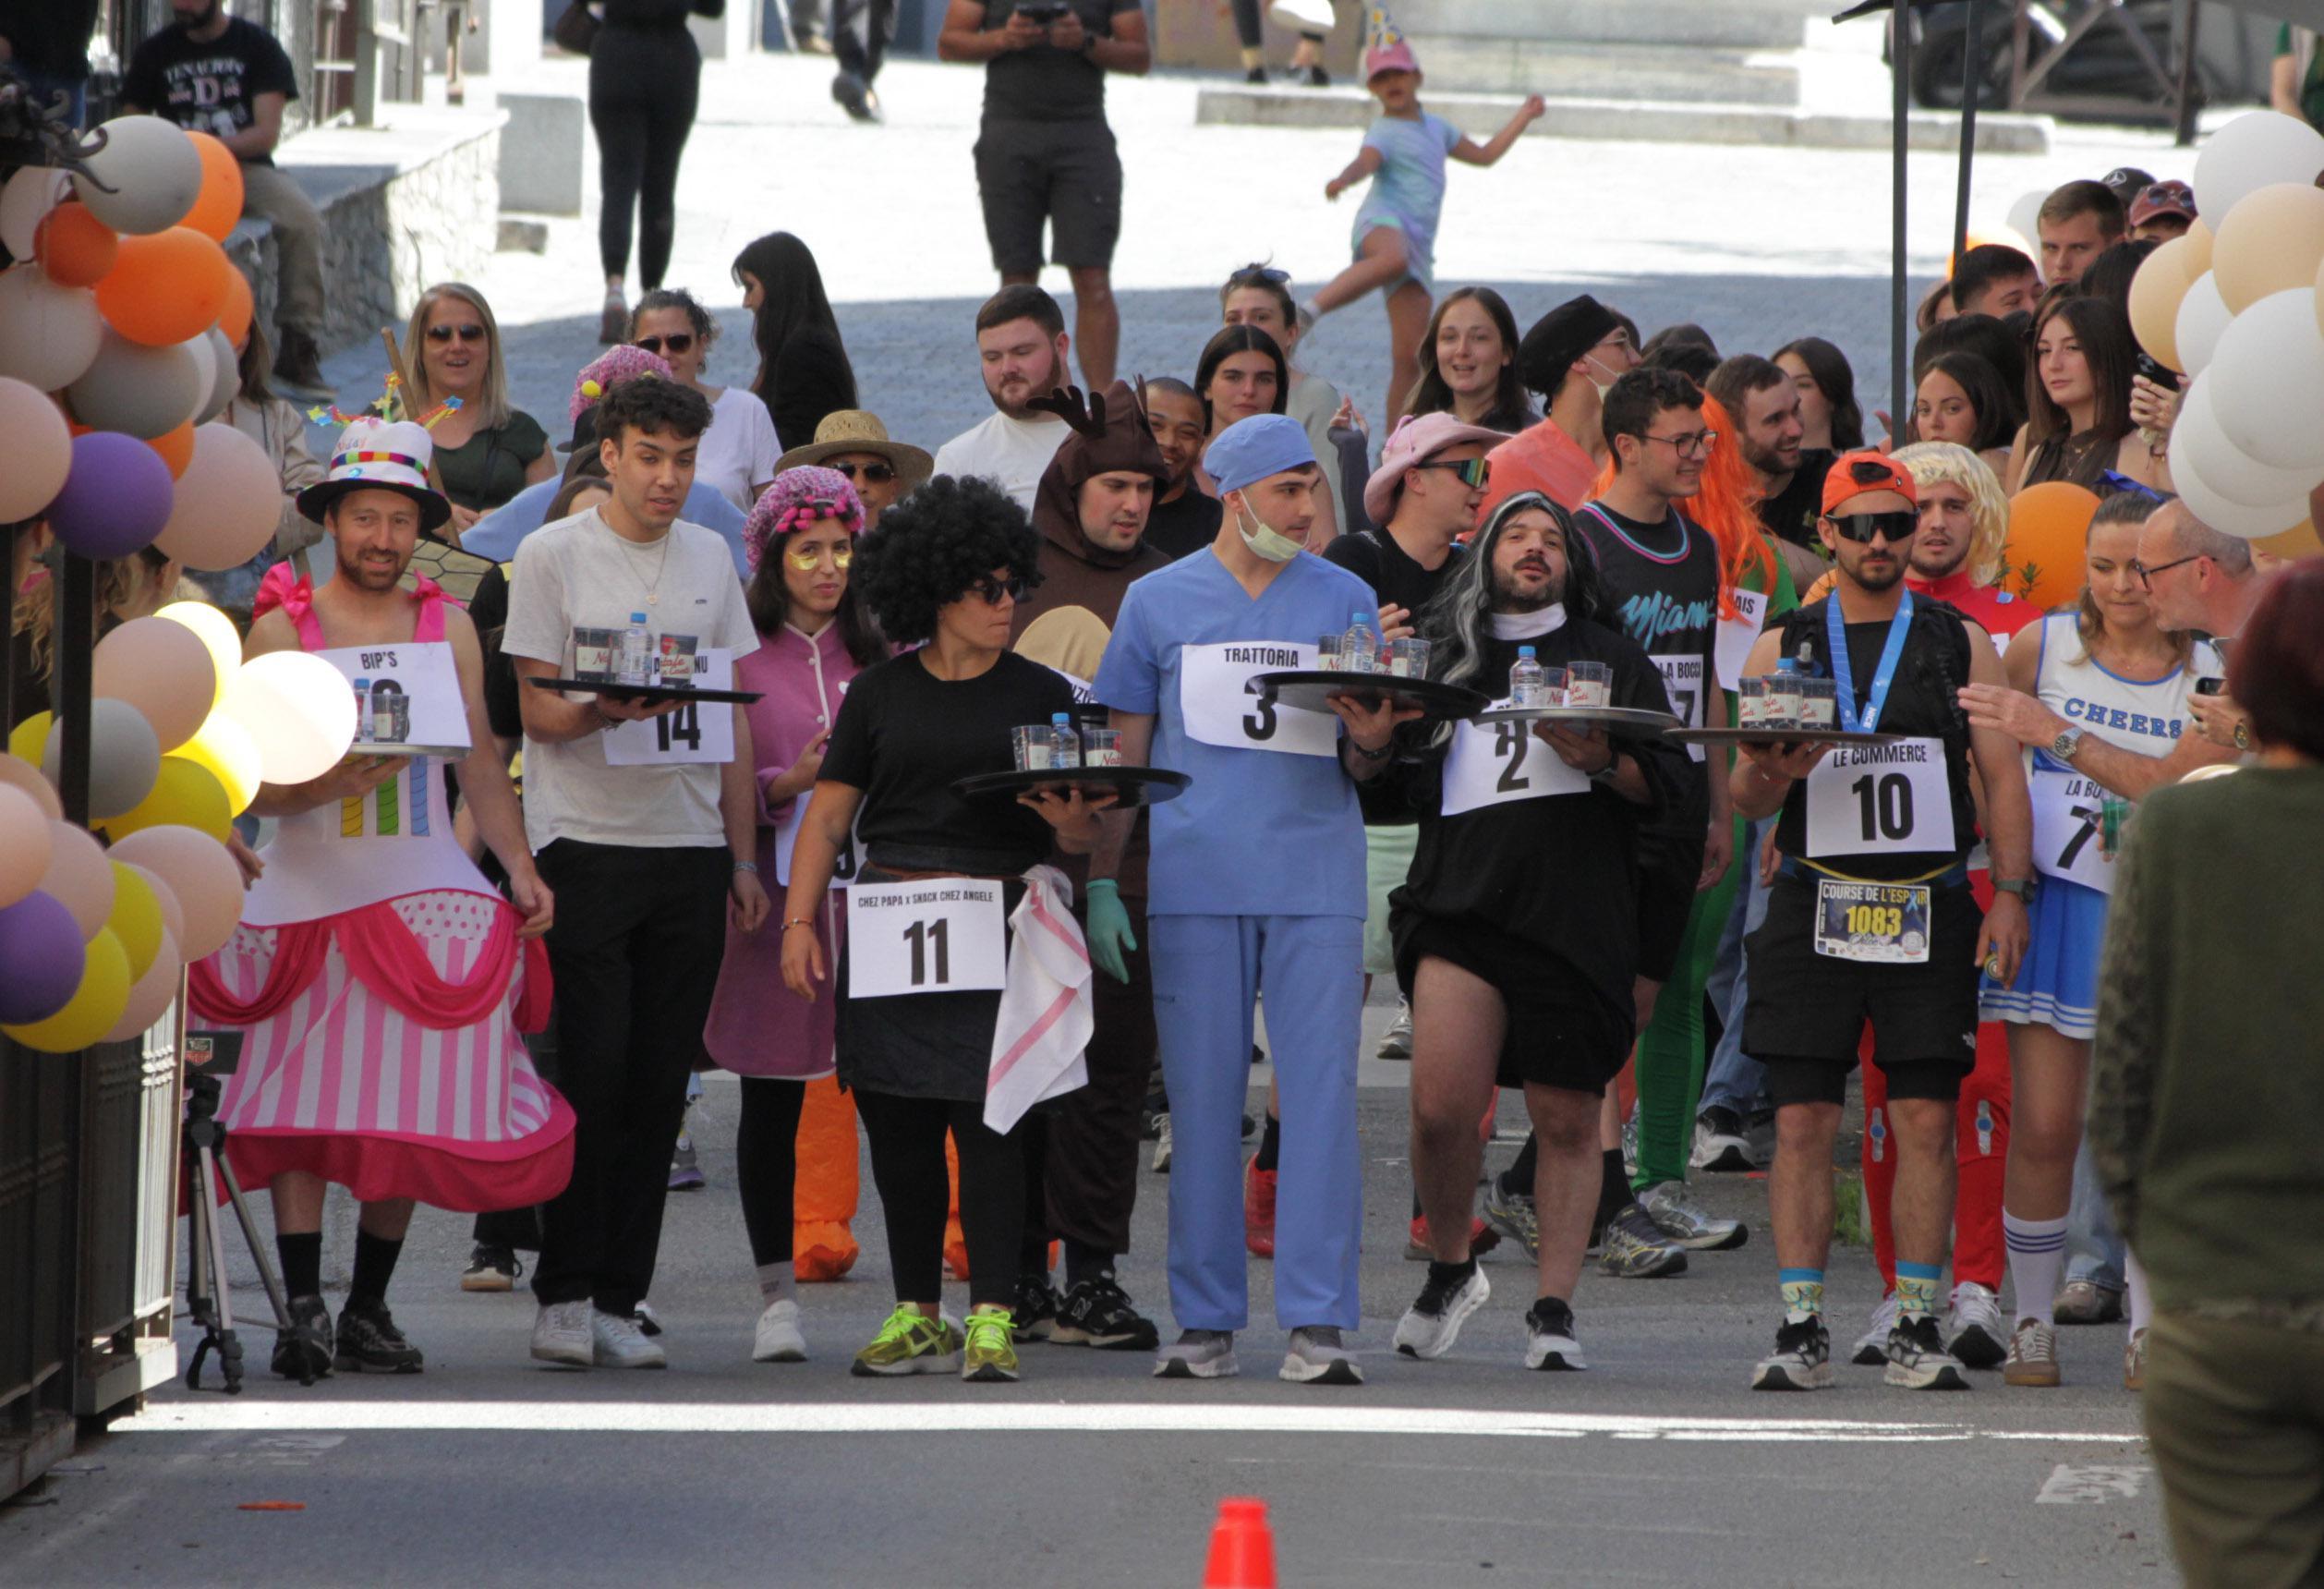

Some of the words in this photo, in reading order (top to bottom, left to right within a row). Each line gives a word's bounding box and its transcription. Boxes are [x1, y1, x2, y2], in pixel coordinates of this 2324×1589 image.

[192, 77, 221, 105] D
[1735, 596, 1756, 614] AIS
[360, 650, 398, 670] BIP'S
[1224, 648, 1299, 668] TRATTORIA
[657, 685, 701, 751] 14
[1242, 676, 1278, 741] 3
[1675, 690, 1695, 728] 7
[2064, 698, 2183, 739] CHEERS
[1495, 729, 1530, 794] 2
[1834, 751, 1847, 769] LE
[1852, 745, 1927, 766] COMMERCE
[2064, 779, 2081, 796] LA
[2085, 781, 2102, 800] BO
[1852, 772, 1914, 842] 10
[2056, 805, 2102, 870] 7
[858, 896, 878, 908] CHEZ
[881, 895, 903, 907] PAPA
[939, 890, 961, 902] CHEZ
[962, 890, 994, 903] ANGELE
[1822, 884, 1863, 901] COURSE
[1865, 887, 1879, 902] DE
[1846, 905, 1902, 937] 1083
[903, 917, 949, 987] 11
